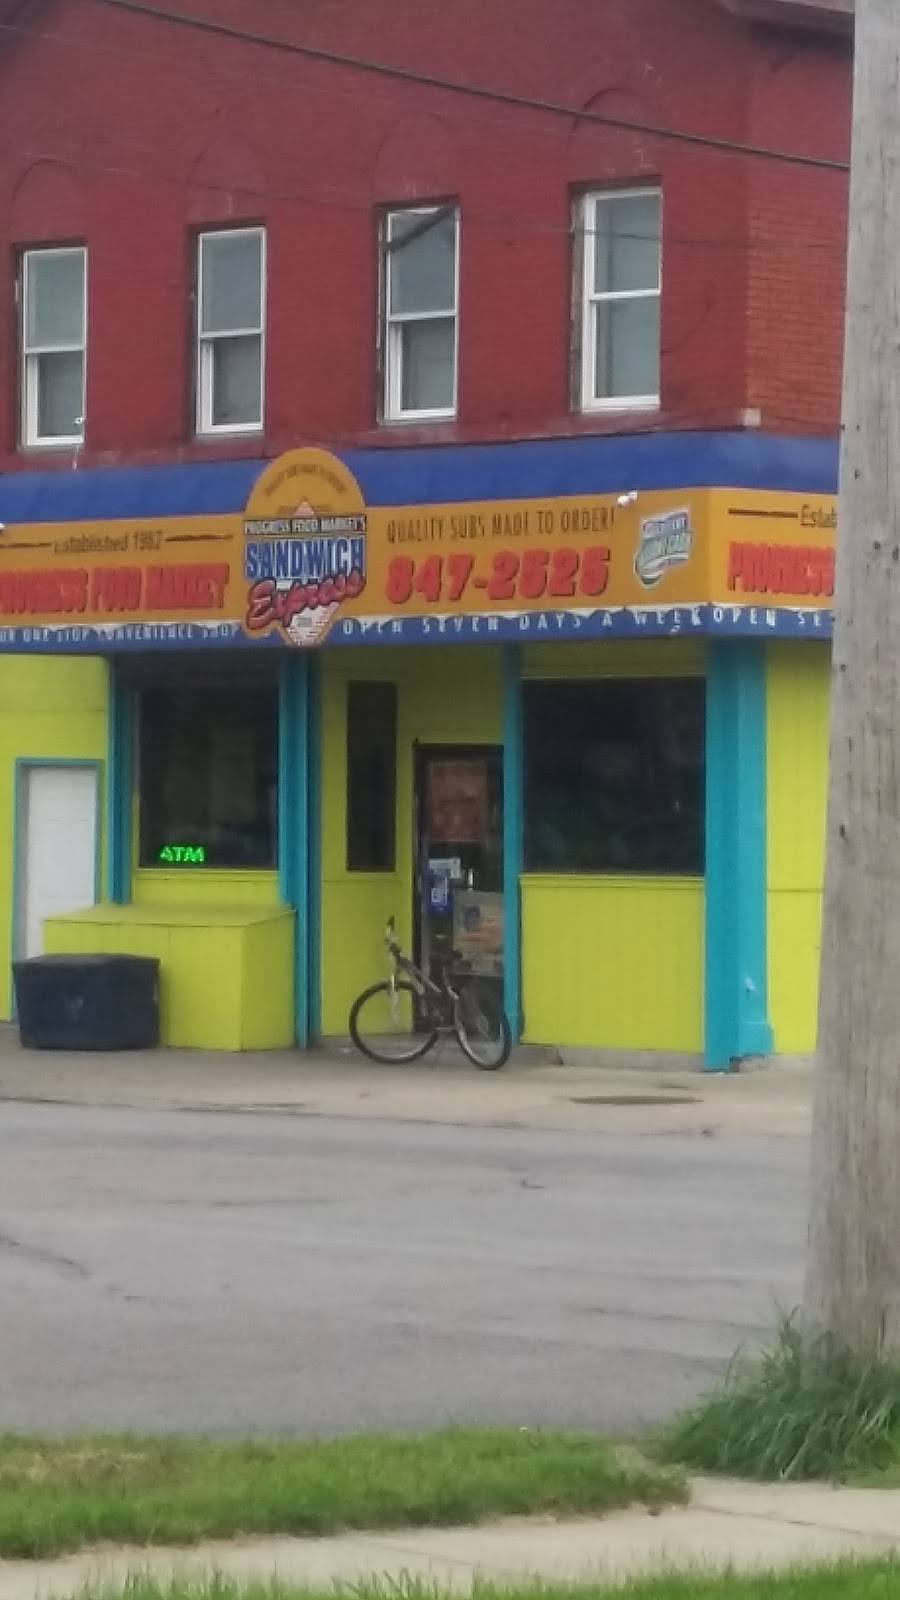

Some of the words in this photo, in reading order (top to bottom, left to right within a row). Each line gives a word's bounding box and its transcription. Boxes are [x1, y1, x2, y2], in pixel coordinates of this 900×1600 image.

[388, 517, 443, 543] QUALITY
[450, 514, 485, 537] SUBS
[492, 512, 528, 536] MADE
[538, 510, 553, 534] TO
[560, 506, 615, 533] ORDER!
[246, 536, 365, 581] SANDWICH
[343, 618, 402, 634] OPEN
[422, 615, 498, 633] SEVEN
[519, 614, 581, 631] DAYS
[602, 612, 613, 627] A
[713, 607, 776, 627] OPEN
[160, 846, 205, 862] ATM
